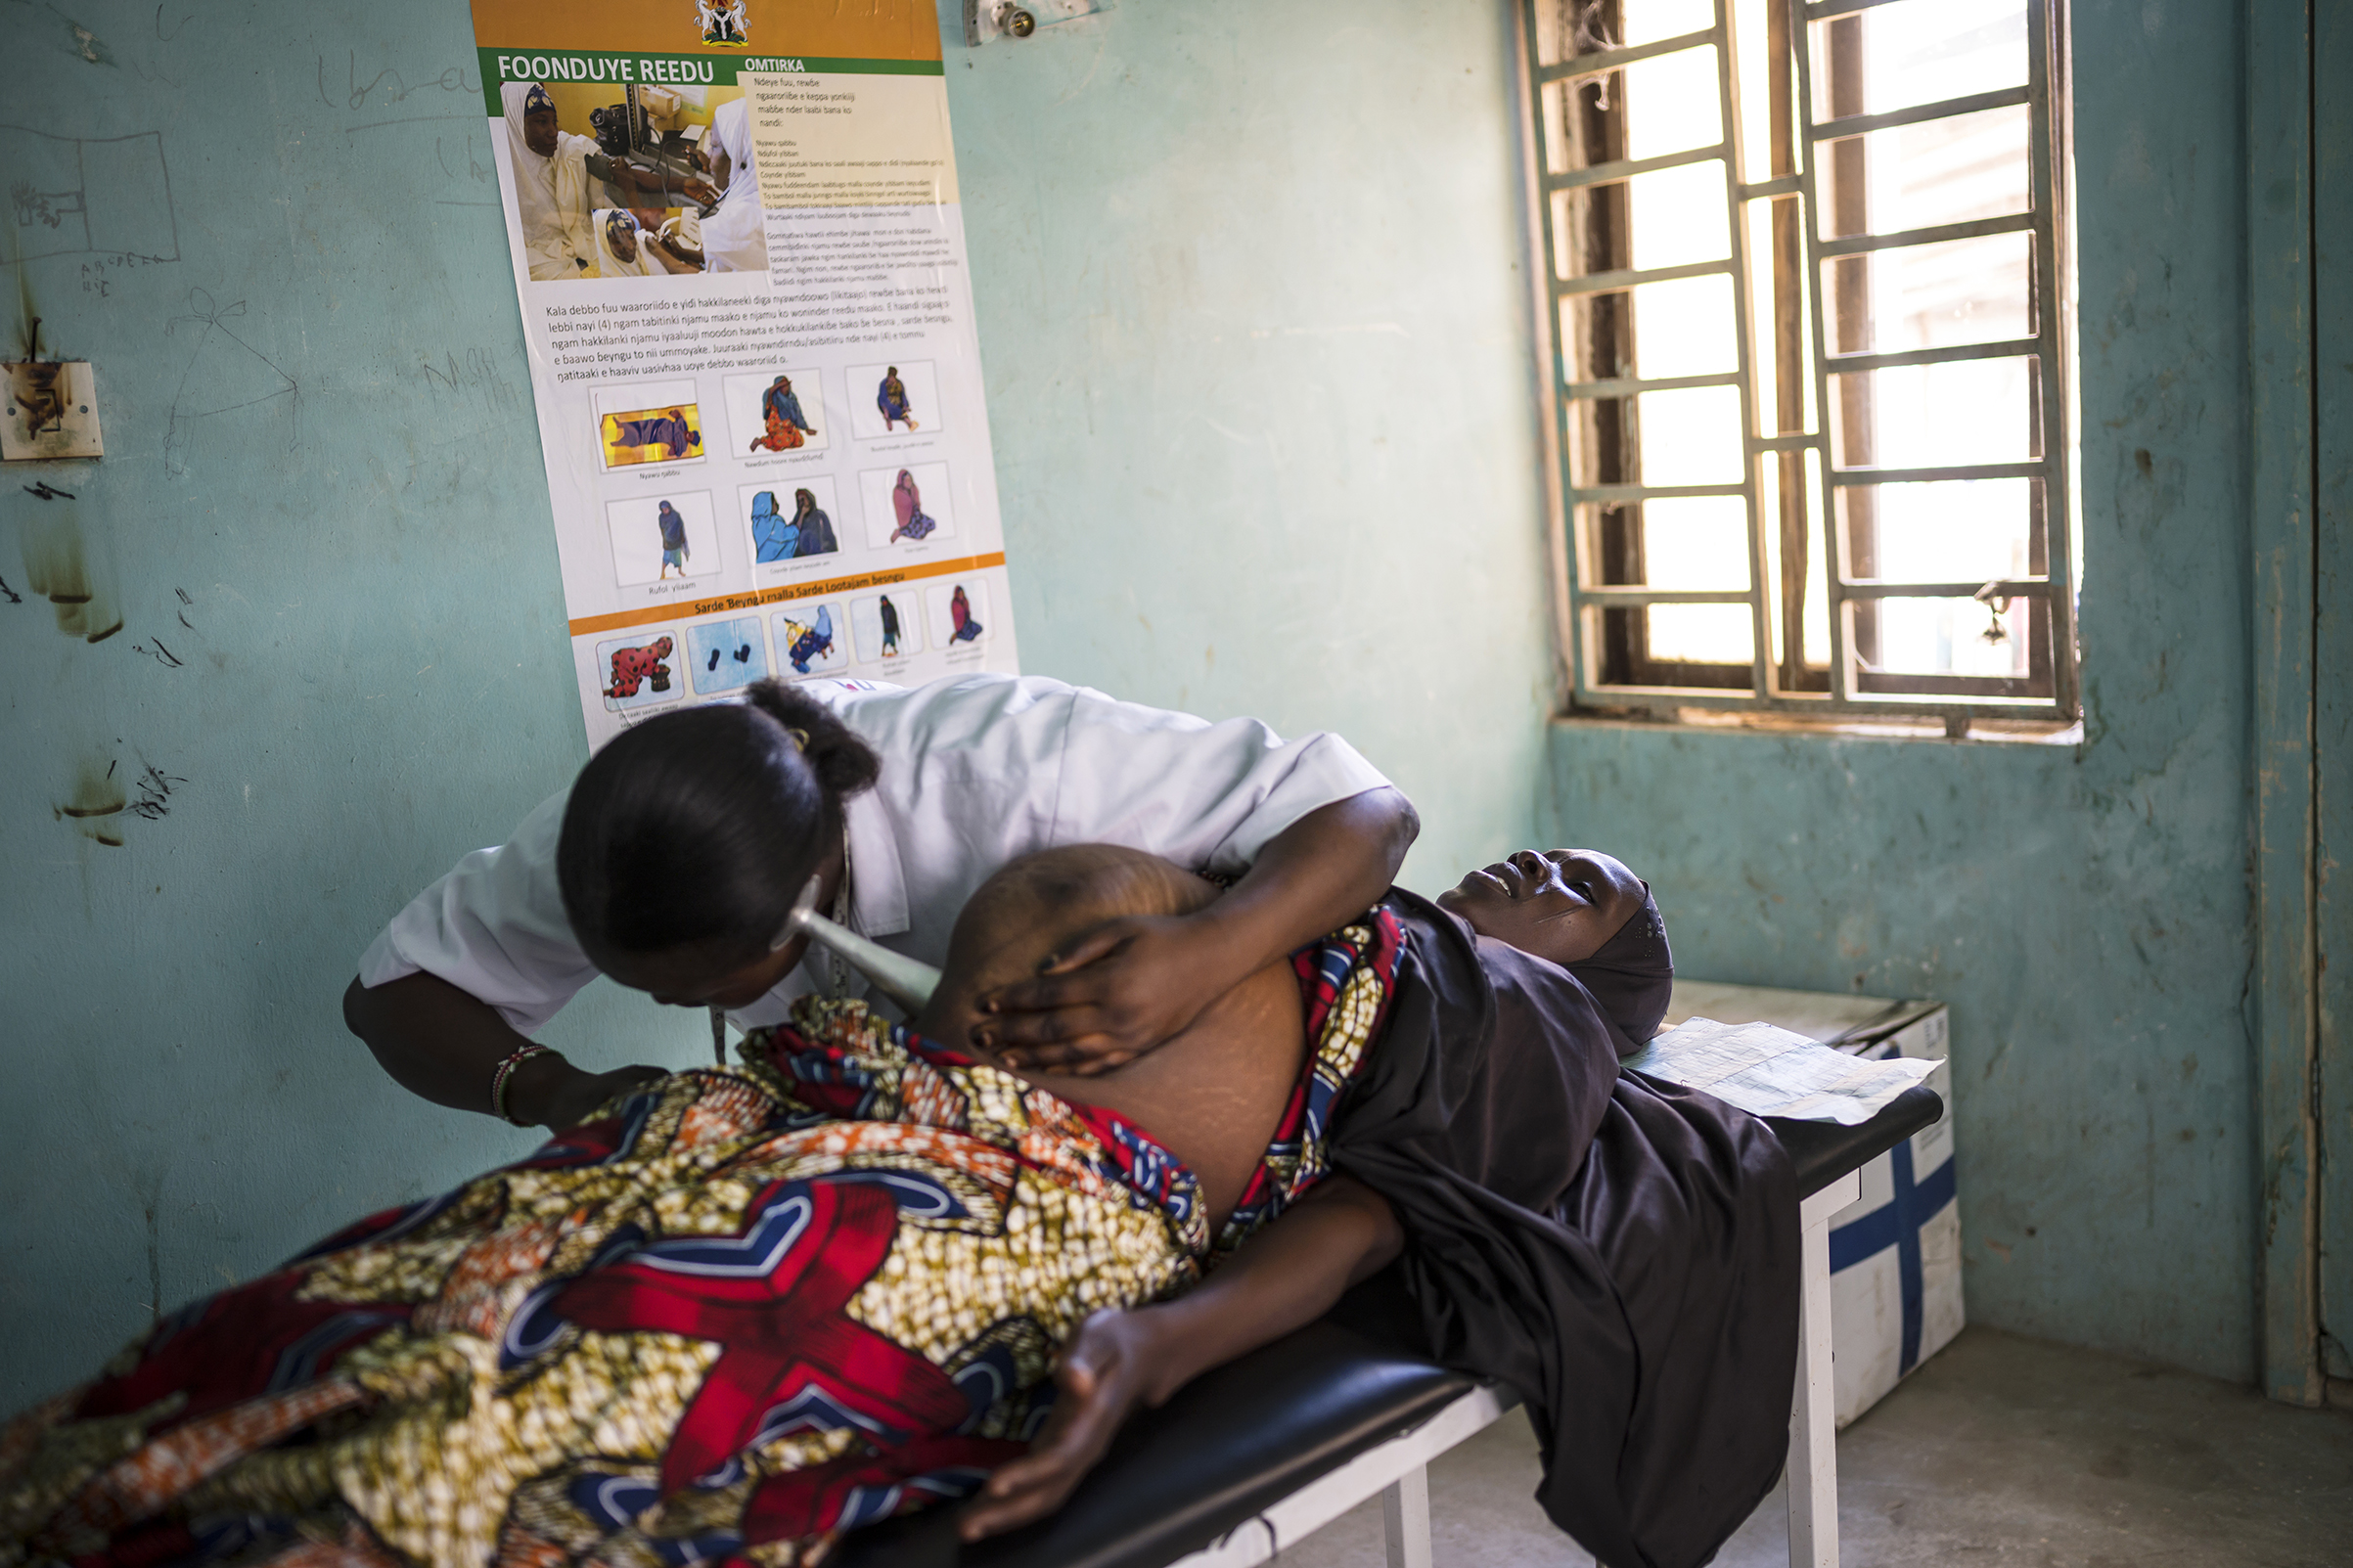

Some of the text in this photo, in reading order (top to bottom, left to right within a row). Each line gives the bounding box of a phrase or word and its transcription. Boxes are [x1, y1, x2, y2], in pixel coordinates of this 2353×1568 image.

[497, 55, 634, 82] FOONDUYE
[639, 60, 715, 84] REEDU
[745, 57, 805, 73] OMTIRKA
[545, 306, 566, 316] Kala
[569, 305, 600, 315] debbo
[601, 303, 617, 313] fuu
[548, 322, 572, 333] lebbi
[575, 321, 595, 332] nayi
[597, 320, 611, 331] (4)
[612, 320, 640, 331] ngam
[641, 316, 679, 327] tabitinki
[681, 316, 708, 326] njamu
[710, 312, 740, 322] maako
[749, 312, 777, 322] njamu
[551, 340, 578, 350] ngam
[581, 335, 628, 346] hakkilanki
[630, 334, 659, 345] njamu
[632, 350, 644, 359] to
[646, 348, 657, 358] nii
[712, 342, 747, 353] Juuraaki
[706, 359, 734, 369] debbo
[695, 600, 724, 614] Sarde
[767, 588, 793, 602] malla
[794, 584, 823, 598] Sarde
[825, 578, 869, 593] Lootajam
